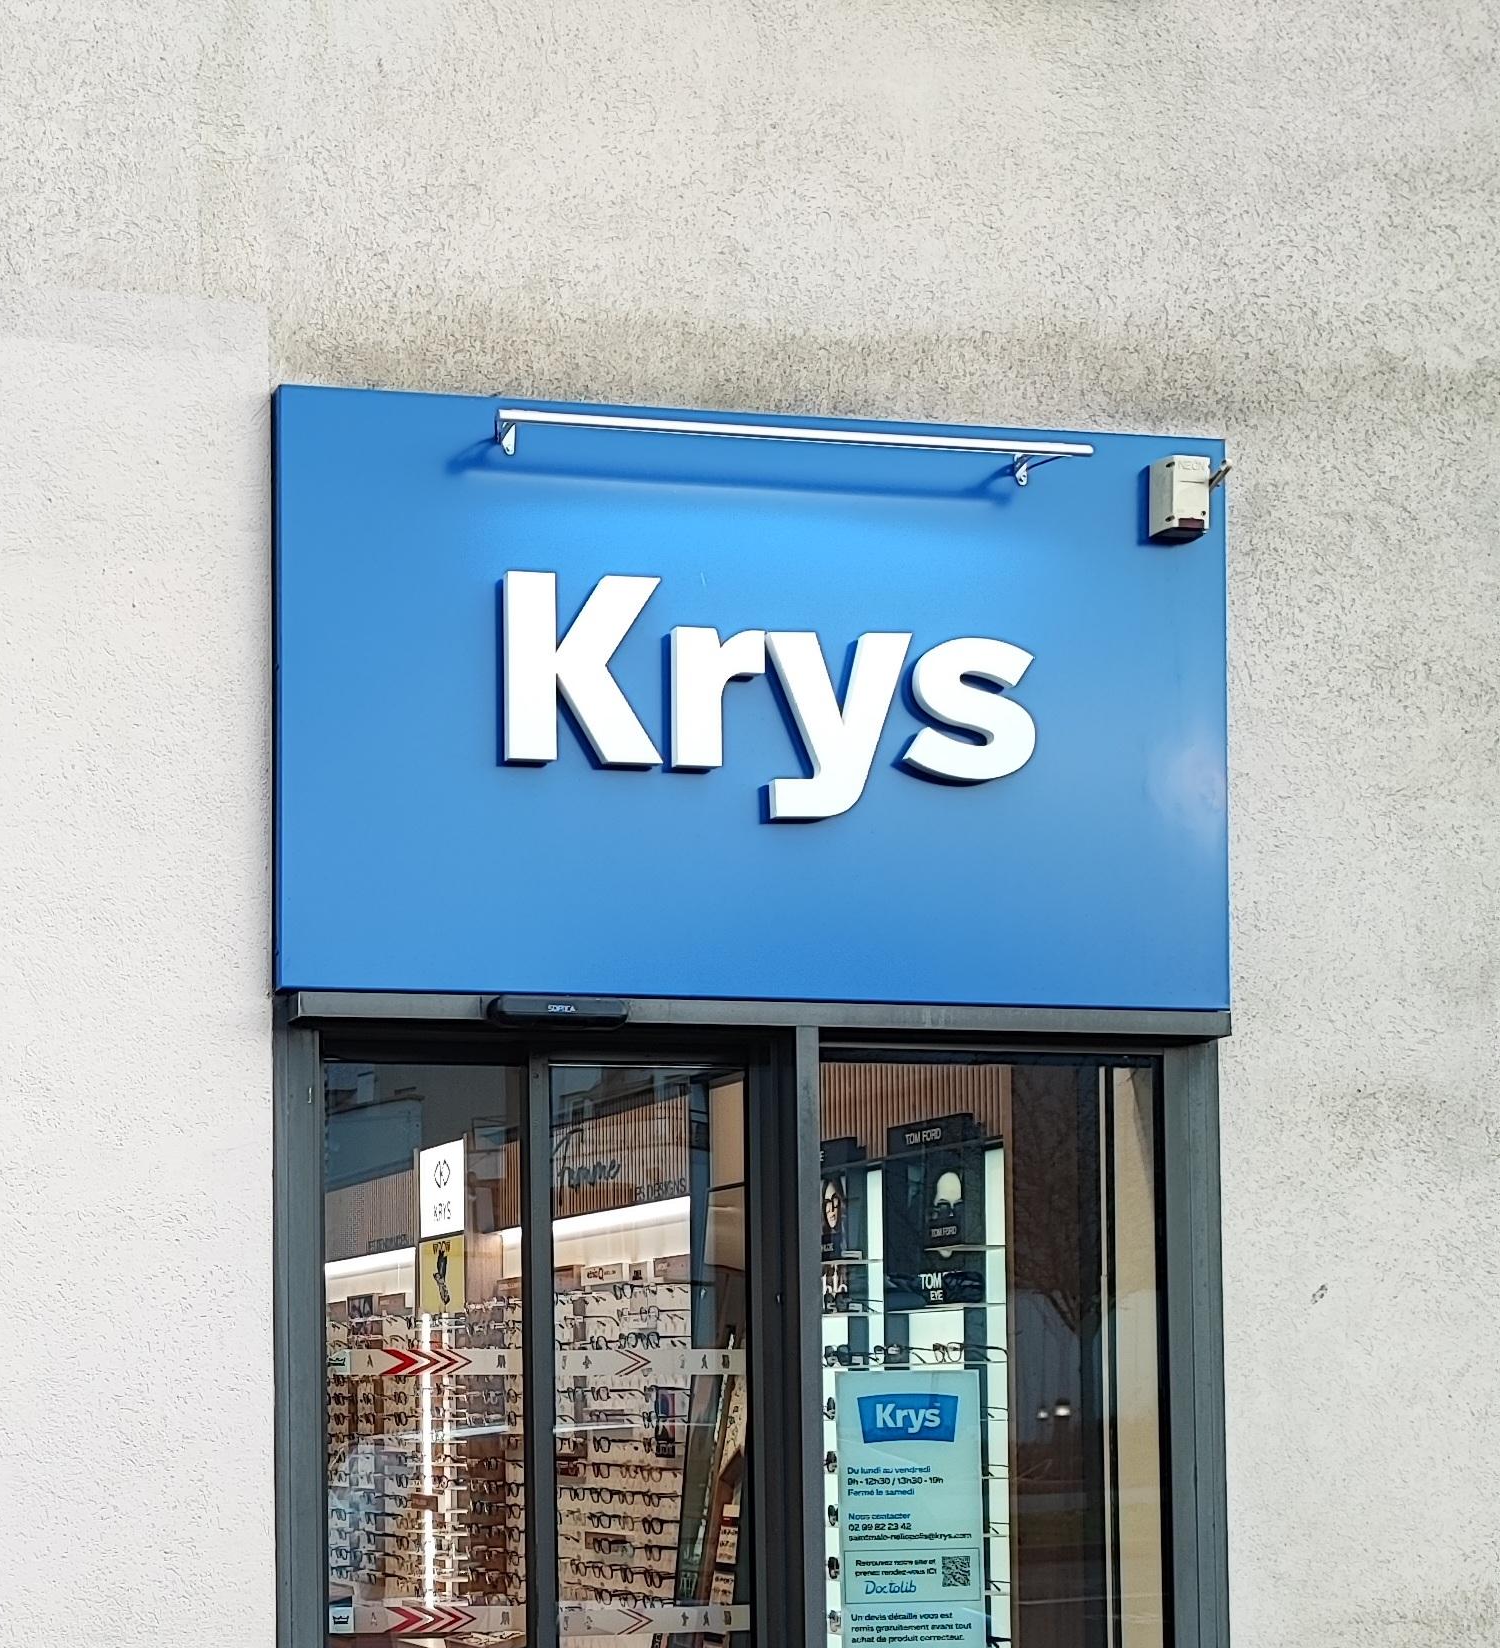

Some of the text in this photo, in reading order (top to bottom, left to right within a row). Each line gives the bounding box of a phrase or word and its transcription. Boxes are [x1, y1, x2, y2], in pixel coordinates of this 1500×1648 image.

[501, 569, 1036, 822] Krys
[905, 1127, 942, 1145] TOM FORD
[918, 1273, 942, 1290] TOM
[876, 1403, 941, 1434] Krys
[861, 1466, 881, 1474] lundi
[895, 1465, 931, 1473] vendredi
[865, 1477, 891, 1485] 12h30
[897, 1476, 922, 1485] 13h30
[885, 1488, 915, 1496] samedi
[848, 1512, 911, 1521] Nous contacter
[864, 1580, 917, 1595] Doctolib
[864, 1613, 887, 1621] devis
[851, 1624, 874, 1632] remis
[875, 1624, 929, 1633] gratuitement
[954, 1622, 972, 1630] tout
[888, 1634, 918, 1644] produit
